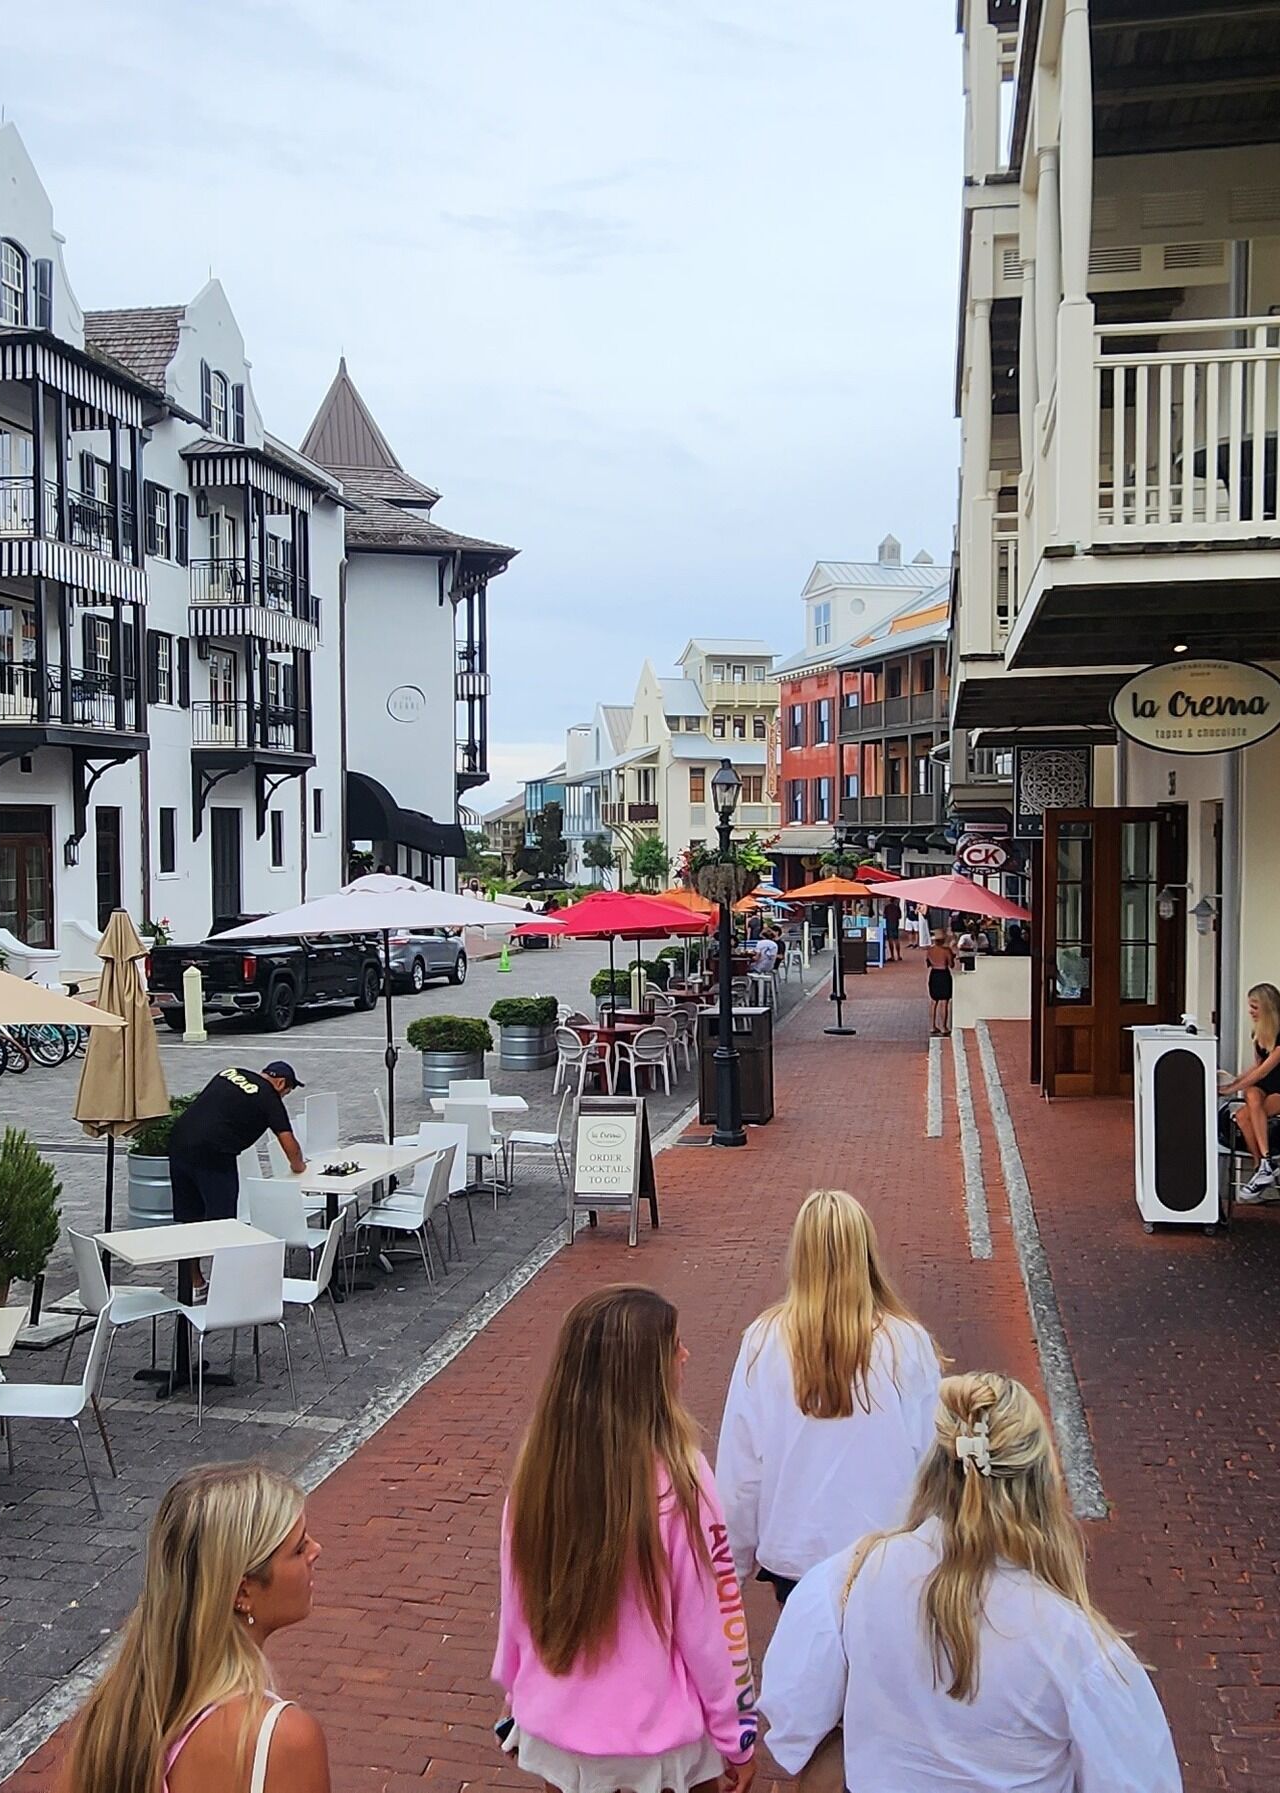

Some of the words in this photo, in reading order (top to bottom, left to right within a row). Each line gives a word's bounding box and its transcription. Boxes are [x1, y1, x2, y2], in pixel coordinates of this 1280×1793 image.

[1131, 692, 1160, 718] la
[1168, 690, 1270, 718] Crema
[1155, 729, 1183, 740] tapas
[1197, 727, 1247, 738] chocolate
[966, 848, 1000, 865] CK
[589, 1154, 622, 1162] ORDER
[579, 1165, 632, 1173] COCKTAILS
[589, 1176, 602, 1184] TO
